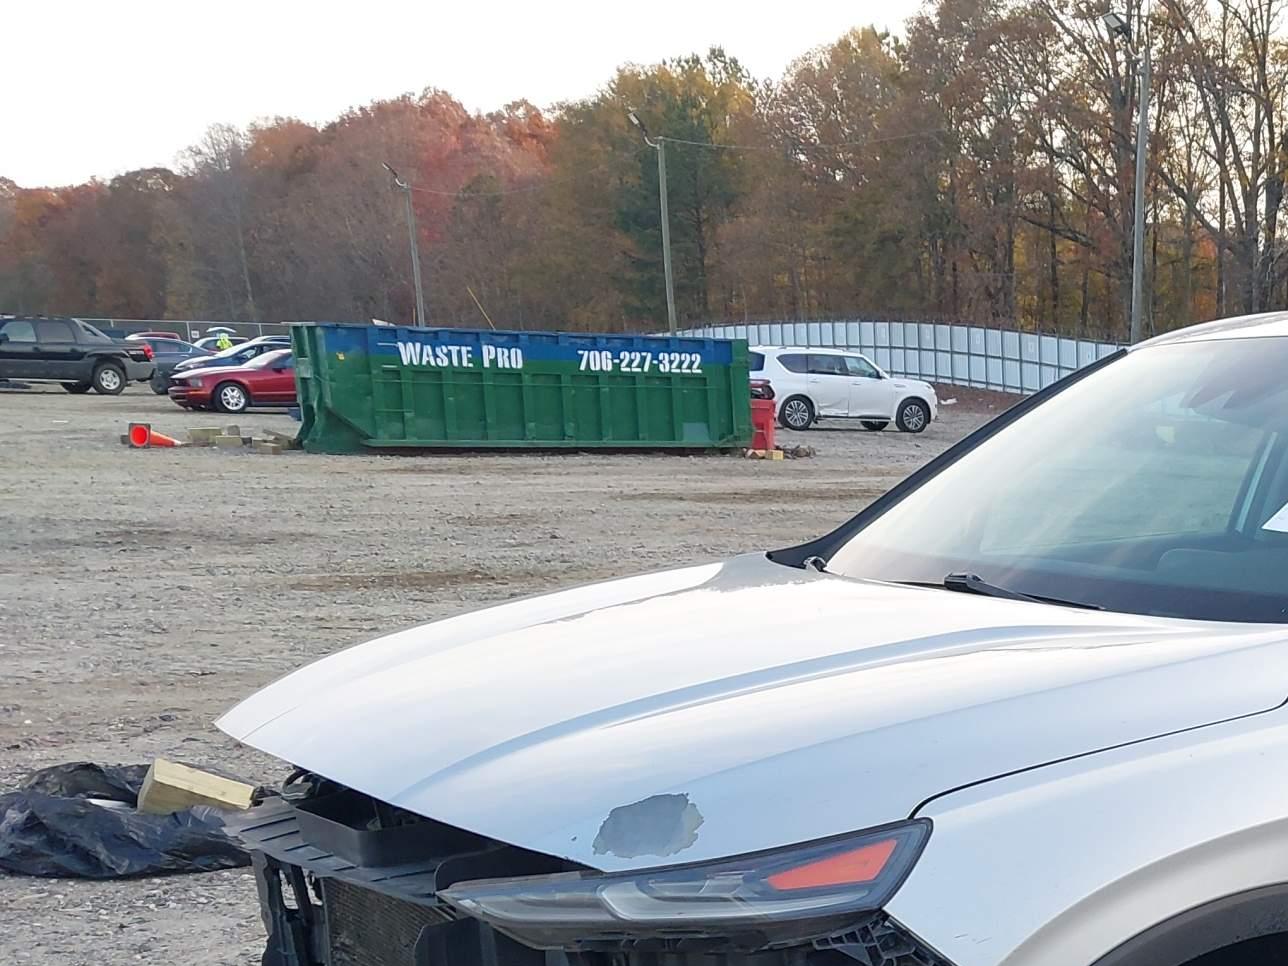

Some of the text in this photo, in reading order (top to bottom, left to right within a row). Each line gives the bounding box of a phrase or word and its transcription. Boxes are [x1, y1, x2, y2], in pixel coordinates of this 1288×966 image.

[398, 342, 524, 369] WASTE PRO
[577, 350, 703, 373] 706-227-3222
